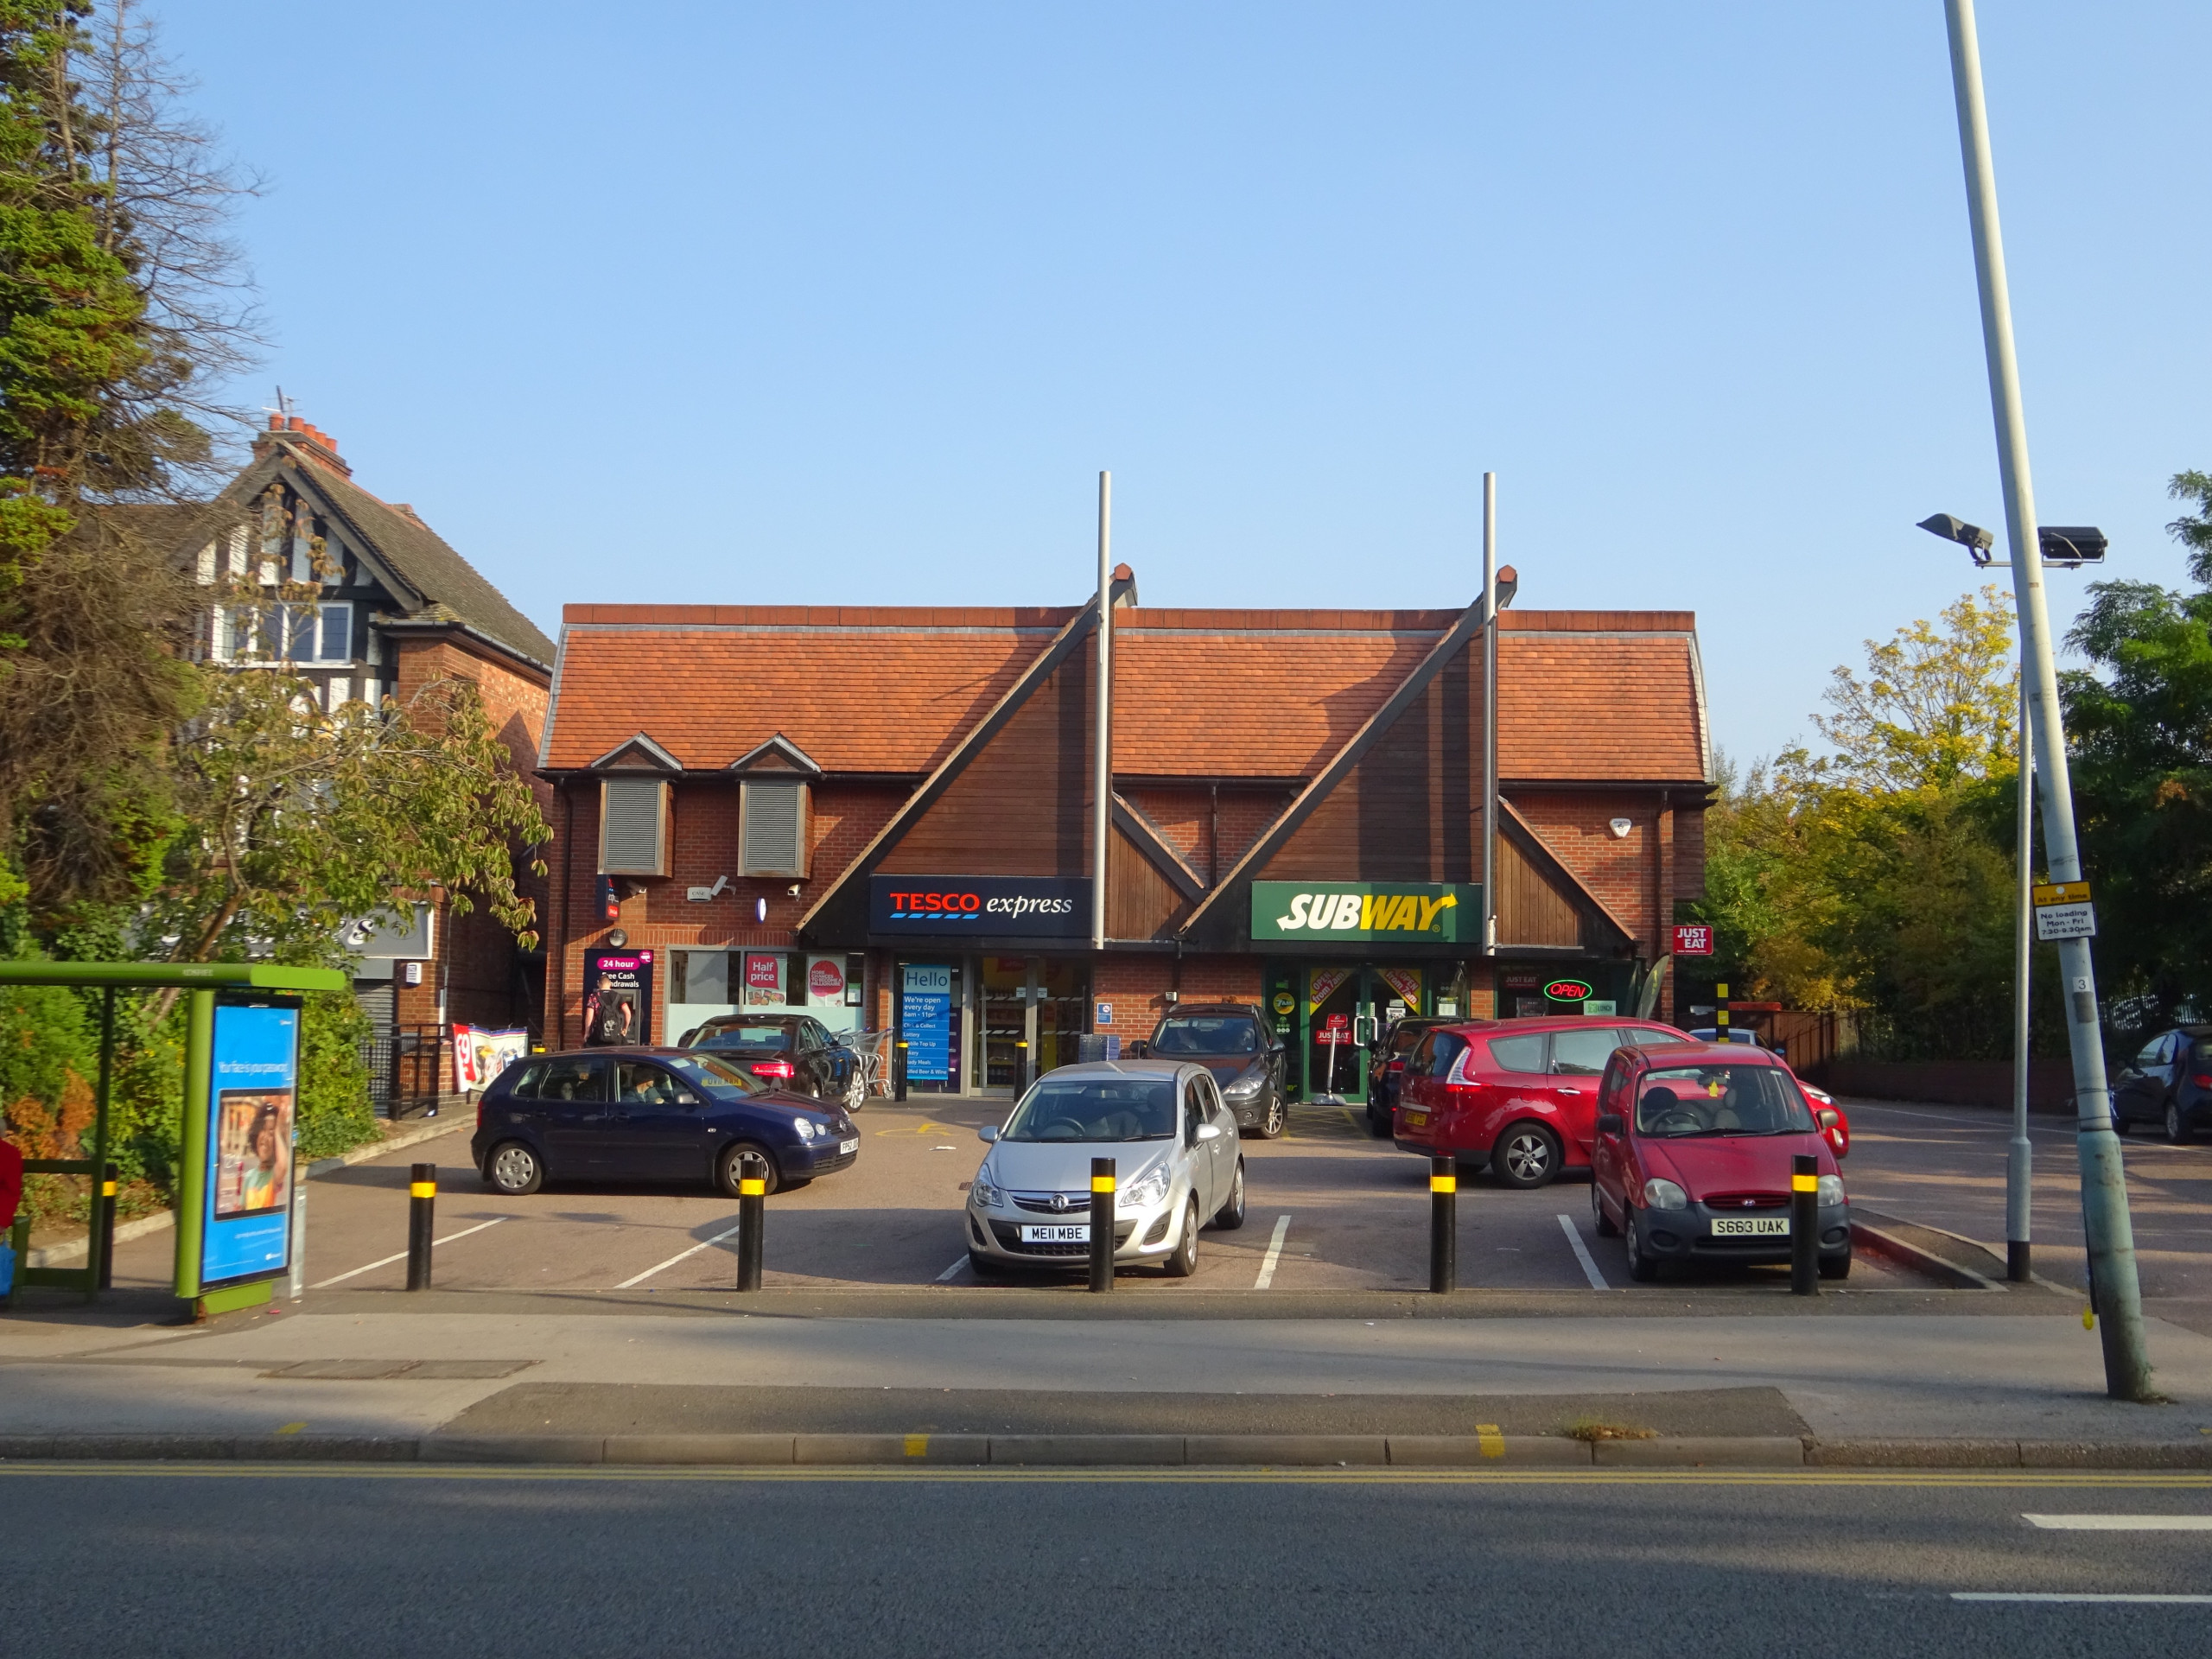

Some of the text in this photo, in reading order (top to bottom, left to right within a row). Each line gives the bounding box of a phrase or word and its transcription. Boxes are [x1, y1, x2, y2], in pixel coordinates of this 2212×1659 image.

[889, 893, 1072, 918] TESCO express
[1276, 892, 1459, 931] SUBWAY
[1677, 928, 1707, 938] JUST
[1684, 938, 1707, 949] EAT
[753, 962, 774, 971] Half
[618, 971, 635, 980] Cash
[751, 971, 774, 982] price
[906, 971, 948, 986] Hello
[1313, 971, 1332, 990] OPEN
[1400, 971, 1419, 990] OPEN
[1312, 972, 1344, 1004] from 7am
[1386, 970, 1403, 989] from
[1402, 986, 1417, 1004] 7am
[1550, 983, 1586, 998] OPEN
[2078, 979, 2086, 990] 3
[1032, 1228, 1083, 1239] ME11 MBE
[1717, 1220, 1784, 1233] S663 UAK
